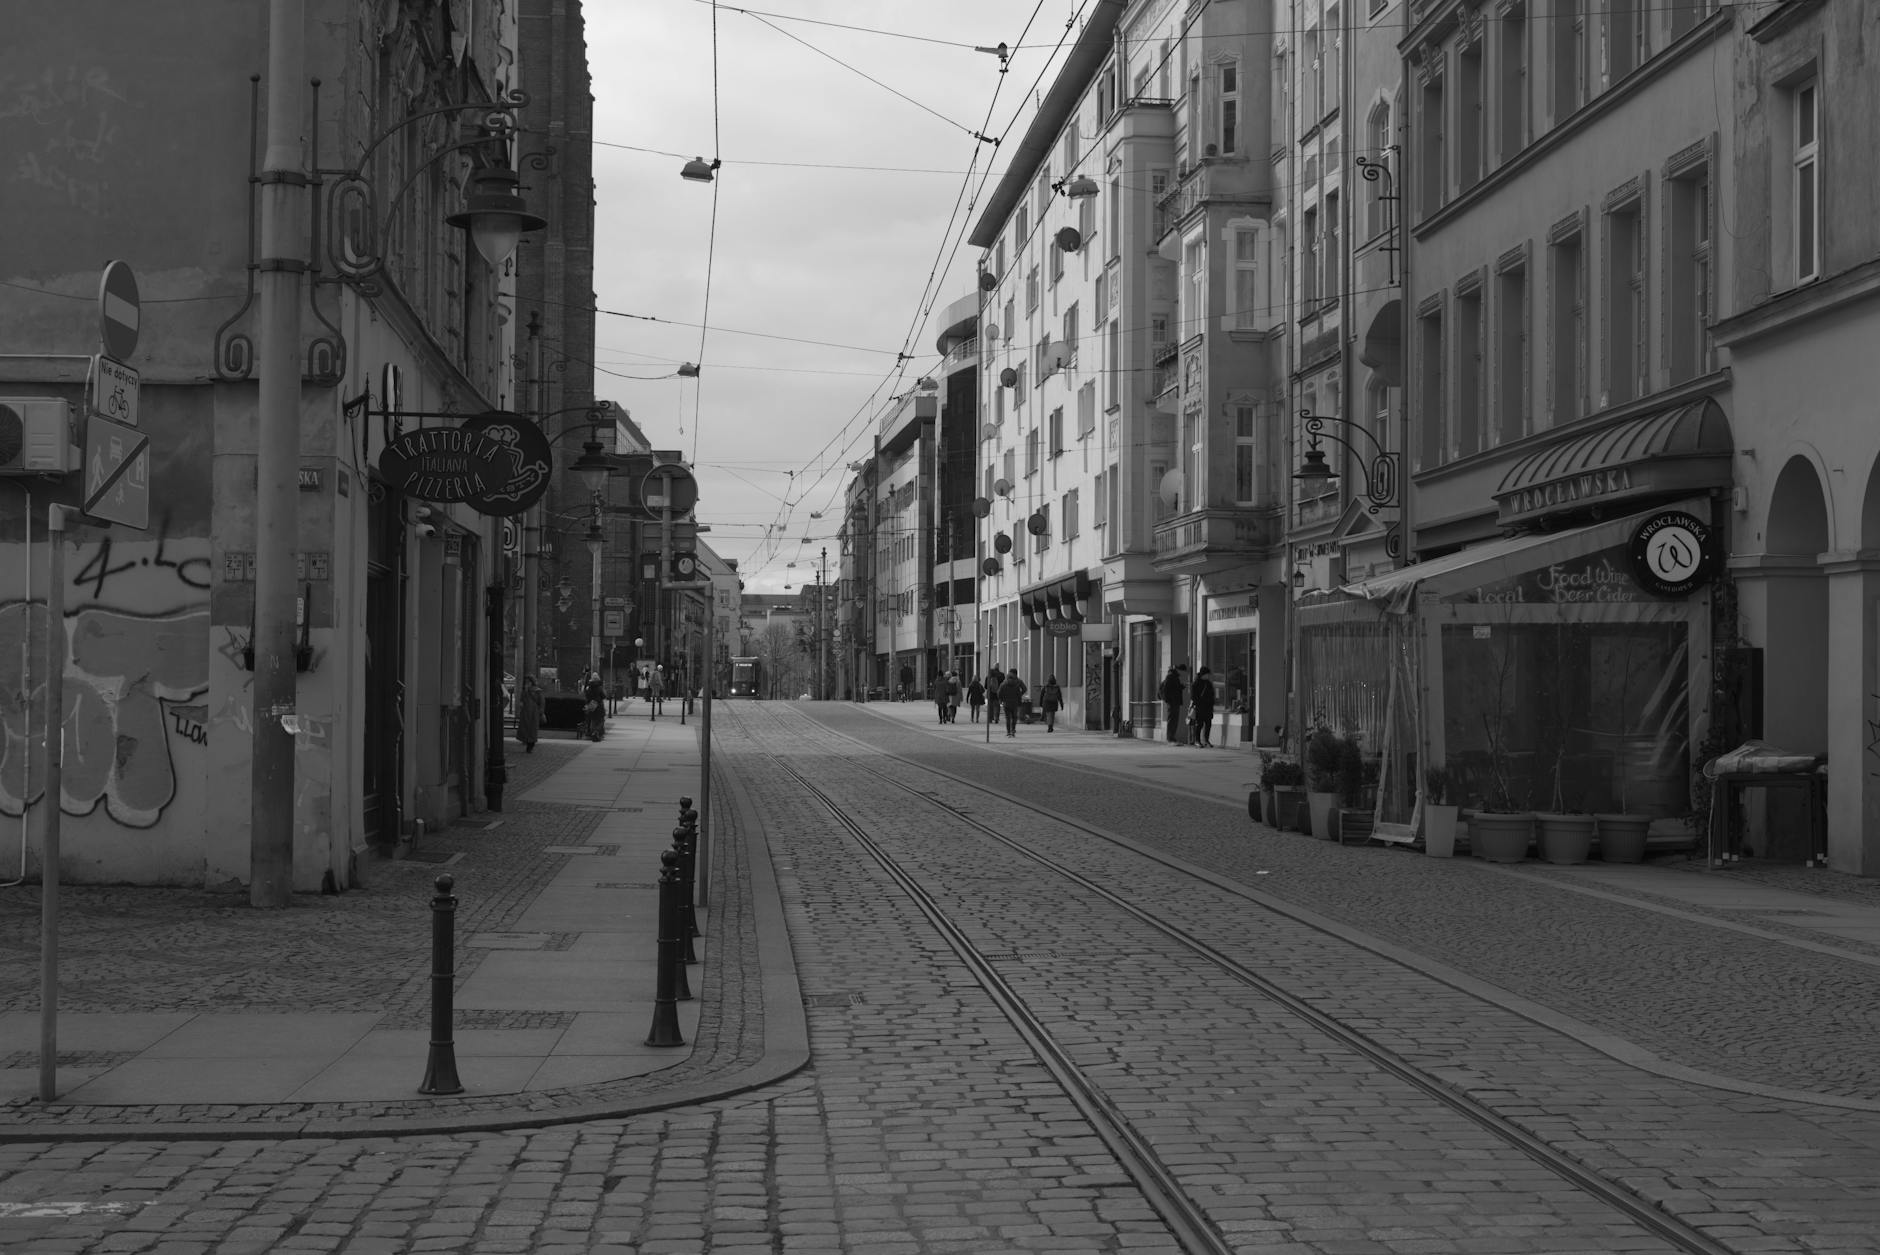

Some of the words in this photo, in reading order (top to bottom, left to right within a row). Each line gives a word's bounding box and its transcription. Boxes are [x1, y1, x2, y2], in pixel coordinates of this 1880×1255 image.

[101, 359, 112, 376] Nie
[114, 367, 138, 390] dotyczy
[391, 430, 500, 463] TRATTORIA
[298, 470, 319, 485] SKA
[421, 456, 469, 473] ITALIANA
[403, 471, 487, 499] PIZZERIA
[1537, 564, 1592, 590] Food
[1596, 558, 1630, 585] Wine
[1553, 584, 1594, 603] Beer
[1596, 584, 1634, 603] Cider
